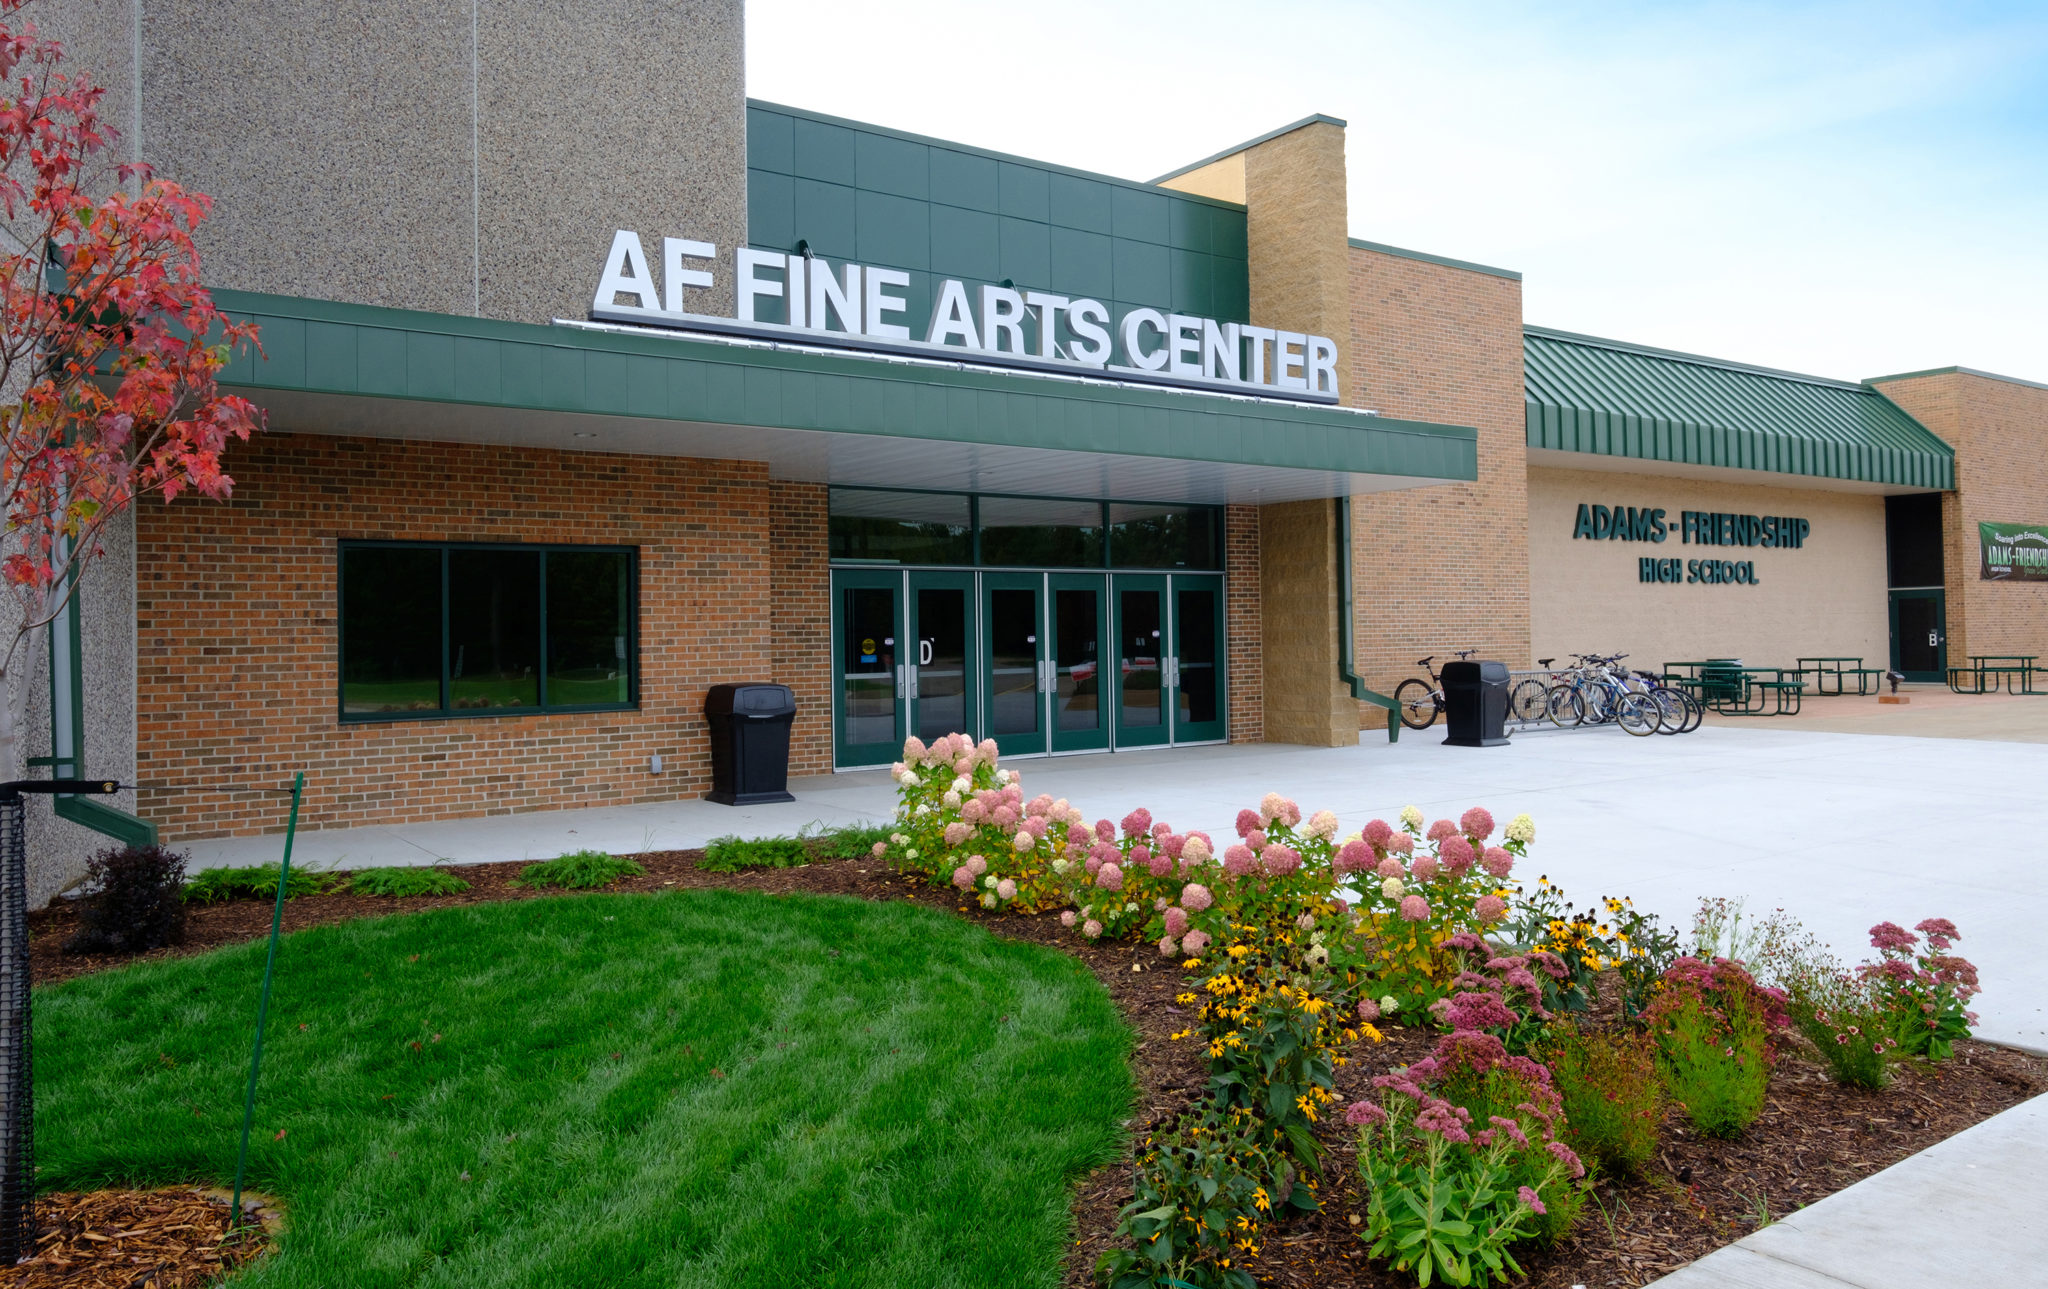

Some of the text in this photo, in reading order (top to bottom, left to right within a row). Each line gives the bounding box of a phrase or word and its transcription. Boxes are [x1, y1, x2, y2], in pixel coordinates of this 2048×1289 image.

[593, 229, 1339, 393] AF FINE ARTS CENTER
[1639, 557, 1759, 584] HIGH SCHOOL
[919, 640, 933, 665] D
[1929, 633, 1937, 646] B
